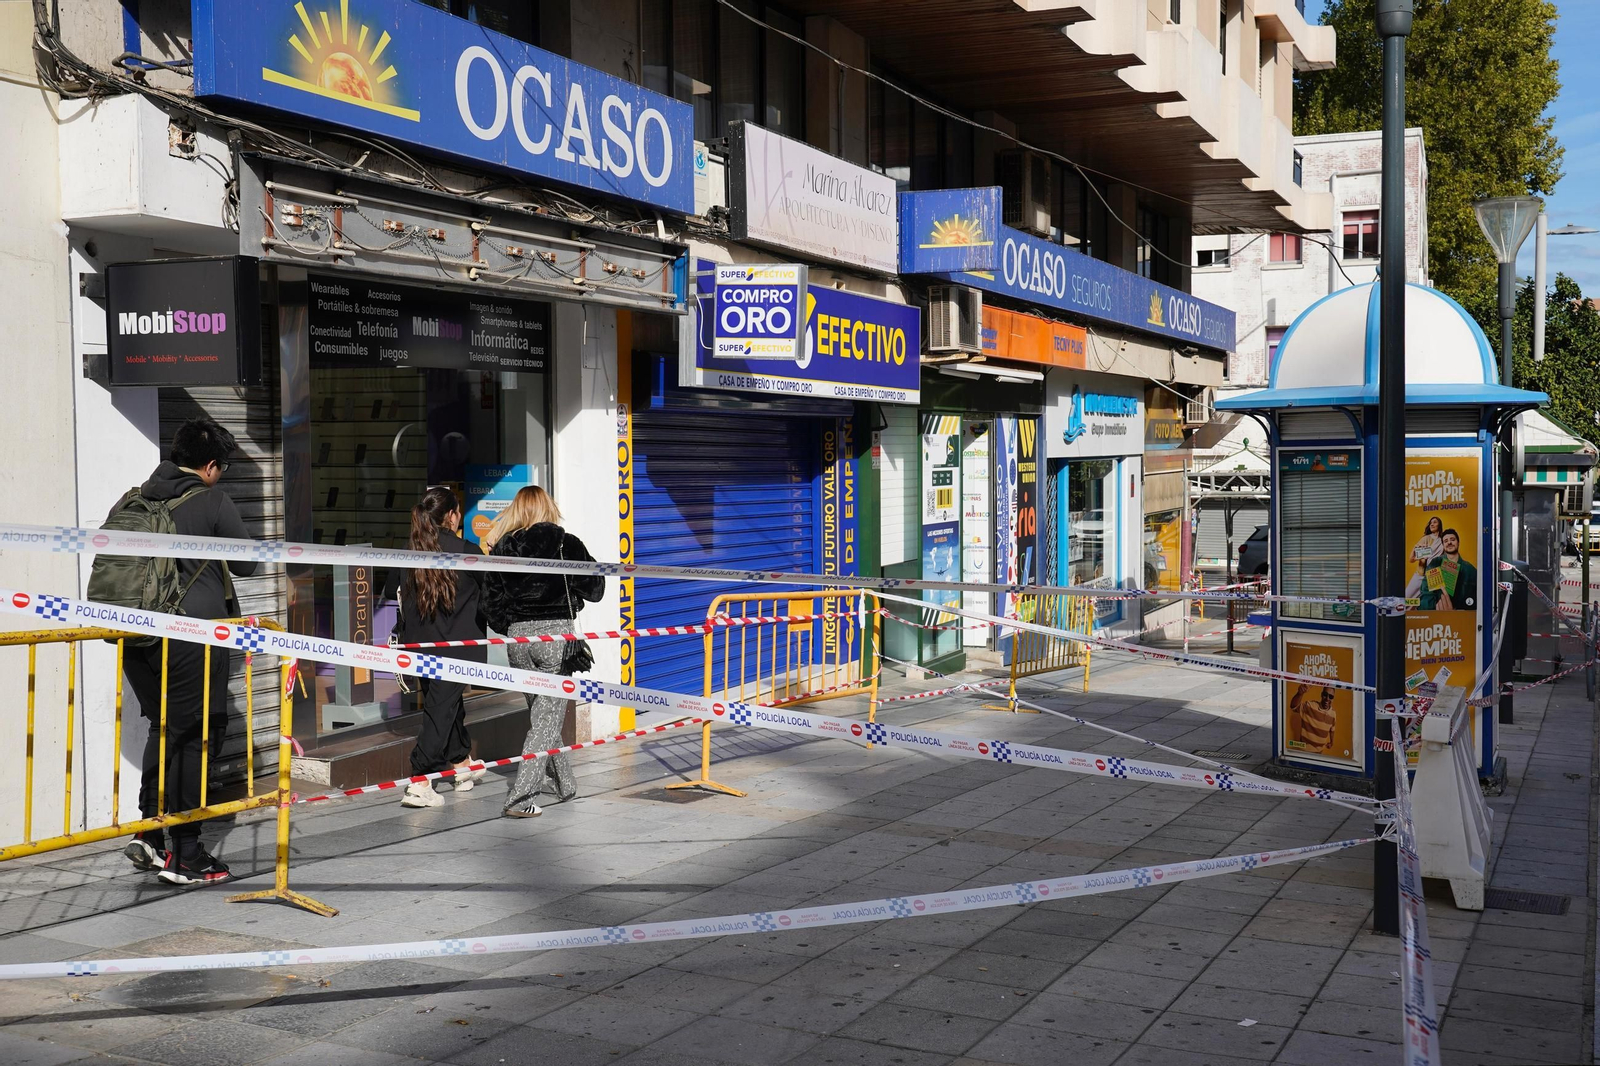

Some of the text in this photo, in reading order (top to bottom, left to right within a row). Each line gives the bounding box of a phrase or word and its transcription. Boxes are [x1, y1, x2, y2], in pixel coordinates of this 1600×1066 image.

[455, 45, 673, 187] OCASO
[802, 162, 892, 216] Marina Álvarez
[778, 196, 850, 233] ARQUITECTURA
[850, 219, 858, 235] Y
[859, 217, 892, 244] DISEÑO
[720, 269, 795, 279] SUPER EFECTIVO
[1003, 237, 1112, 312] OCASO SEGUROS
[311, 281, 350, 296] Wearables
[367, 289, 401, 301] Accesorios
[722, 288, 793, 304] COMPRO
[318, 299, 399, 317] Portátiles & sobremesa
[469, 302, 512, 315] Imagen & sonido
[119, 310, 226, 335] MobiStop
[480, 316, 543, 331] Smartphones & tablets
[721, 306, 792, 334] ORO
[1169, 295, 1227, 344] OCASO SEGUROS
[310, 324, 352, 338] Conectividad
[357, 321, 398, 338] Telefonía
[412, 316, 462, 340] MobiStop
[471, 330, 529, 350] Informática
[817, 313, 906, 366] EFECTIVO
[1053, 336, 1083, 355] TECNY PLUS
[315, 341, 368, 356] Consumibles
[380, 346, 408, 361] juegos
[530, 346, 544, 355] REDES
[718, 343, 792, 353] SUPER EFECTIVO
[126, 354, 218, 364] Mobile Mobility Accessories
[469, 351, 499, 363] Televisión
[500, 357, 543, 368] SERVICIO TÉCNICO
[718, 374, 813, 394] CASA DE EMPEÑO Y COMPRO ORO
[834, 386, 906, 401] CASA DE EMPEÑO Y COMPRO ORO
[1155, 423, 1170, 438] FOTO
[825, 430, 834, 460] ORO
[484, 469, 513, 477] LEBARA
[1018, 462, 1036, 473] WESTERN
[617, 440, 630, 520] ORO
[824, 465, 835, 499] VALE
[1022, 472, 1036, 483] UNION
[1408, 470, 1455, 489] AHORA
[469, 487, 495, 495] LEBARA
[1440, 502, 1467, 511] JUGADO
[1018, 491, 1036, 539] ria
[824, 503, 835, 558] FUTURO
[845, 528, 854, 563] DE
[354, 567, 369, 645] Orange
[75, 604, 156, 628] POLICÍA LOCAL
[165, 624, 181, 632] LÍNEA
[1407, 624, 1452, 642] AHORA
[271, 636, 345, 657] POLICÍA LOCAL
[1304, 653, 1331, 666] AHORA
[1438, 655, 1465, 663] JUGADO
[448, 664, 515, 683] POLICÍA LOCAL
[1299, 664, 1338, 678] SIEMPRE
[609, 688, 641, 702] POLICÍA
[643, 694, 670, 707] LOCAL
[756, 711, 786, 724] POLICÍA
[787, 716, 811, 728] LOCAL
[890, 731, 919, 743] POLICÍA
[920, 736, 942, 747] LOCAL
[1014, 750, 1041, 760] POLICÍA
[1041, 753, 1063, 764] LOCAL
[1129, 766, 1154, 776] POLICÍA
[1154, 769, 1175, 779] LOCAL
